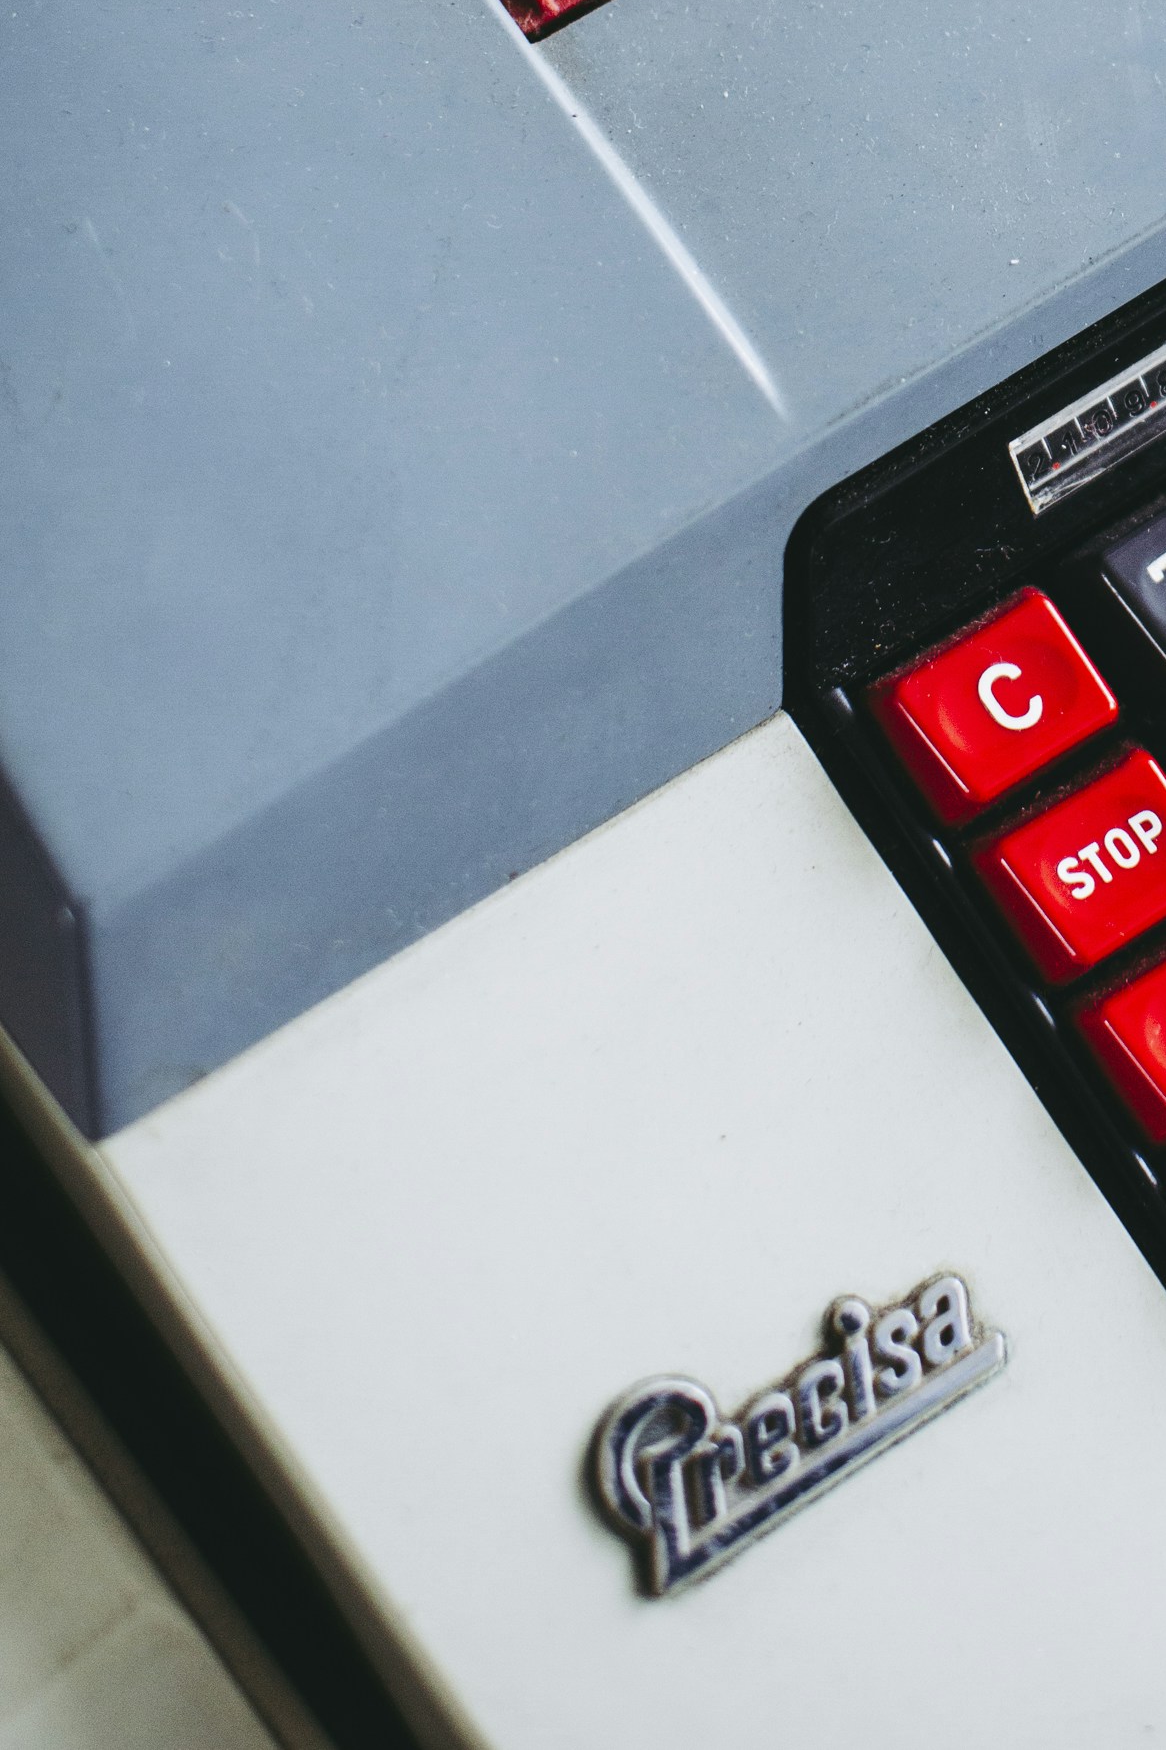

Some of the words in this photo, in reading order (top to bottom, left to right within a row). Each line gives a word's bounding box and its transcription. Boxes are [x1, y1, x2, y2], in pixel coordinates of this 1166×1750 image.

[977, 662, 1043, 731] C
[1056, 810, 1163, 900] STOP
[598, 1274, 985, 1595] Precisa
